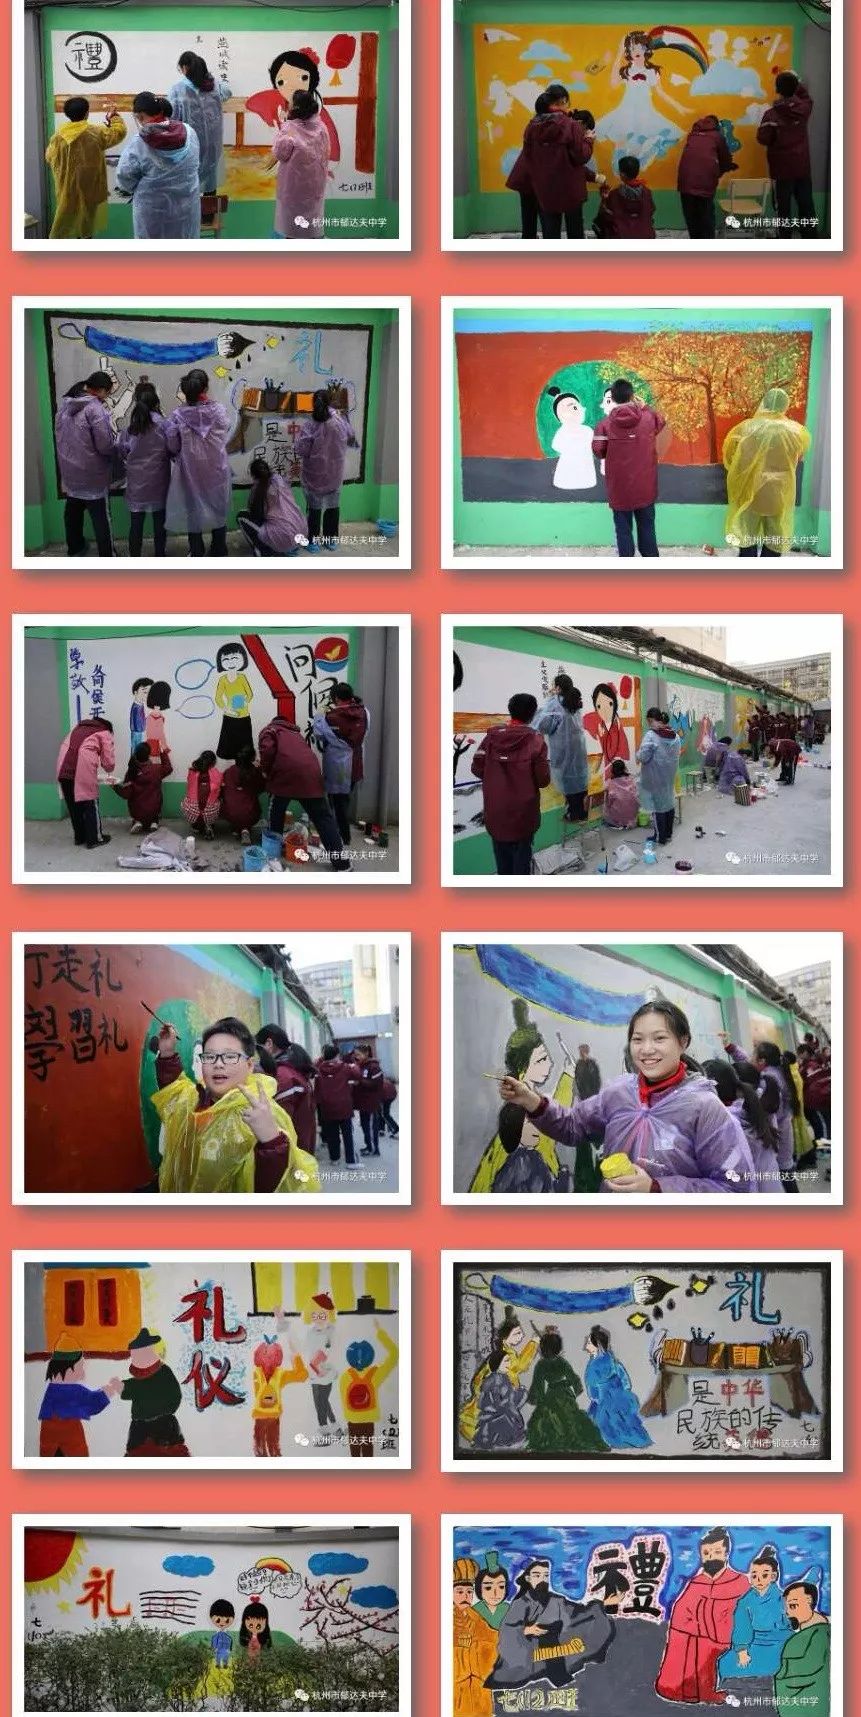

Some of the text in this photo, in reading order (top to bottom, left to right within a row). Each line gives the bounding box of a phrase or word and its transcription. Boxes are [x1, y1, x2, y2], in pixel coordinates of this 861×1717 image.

[719, 1270, 782, 1325] 礼
[172, 1279, 248, 1413] 礼仪
[677, 1405, 783, 1435] 民族的传
[691, 1378, 765, 1408] 是中华
[76, 1566, 132, 1620] 礼
[591, 1540, 671, 1617] 禮
